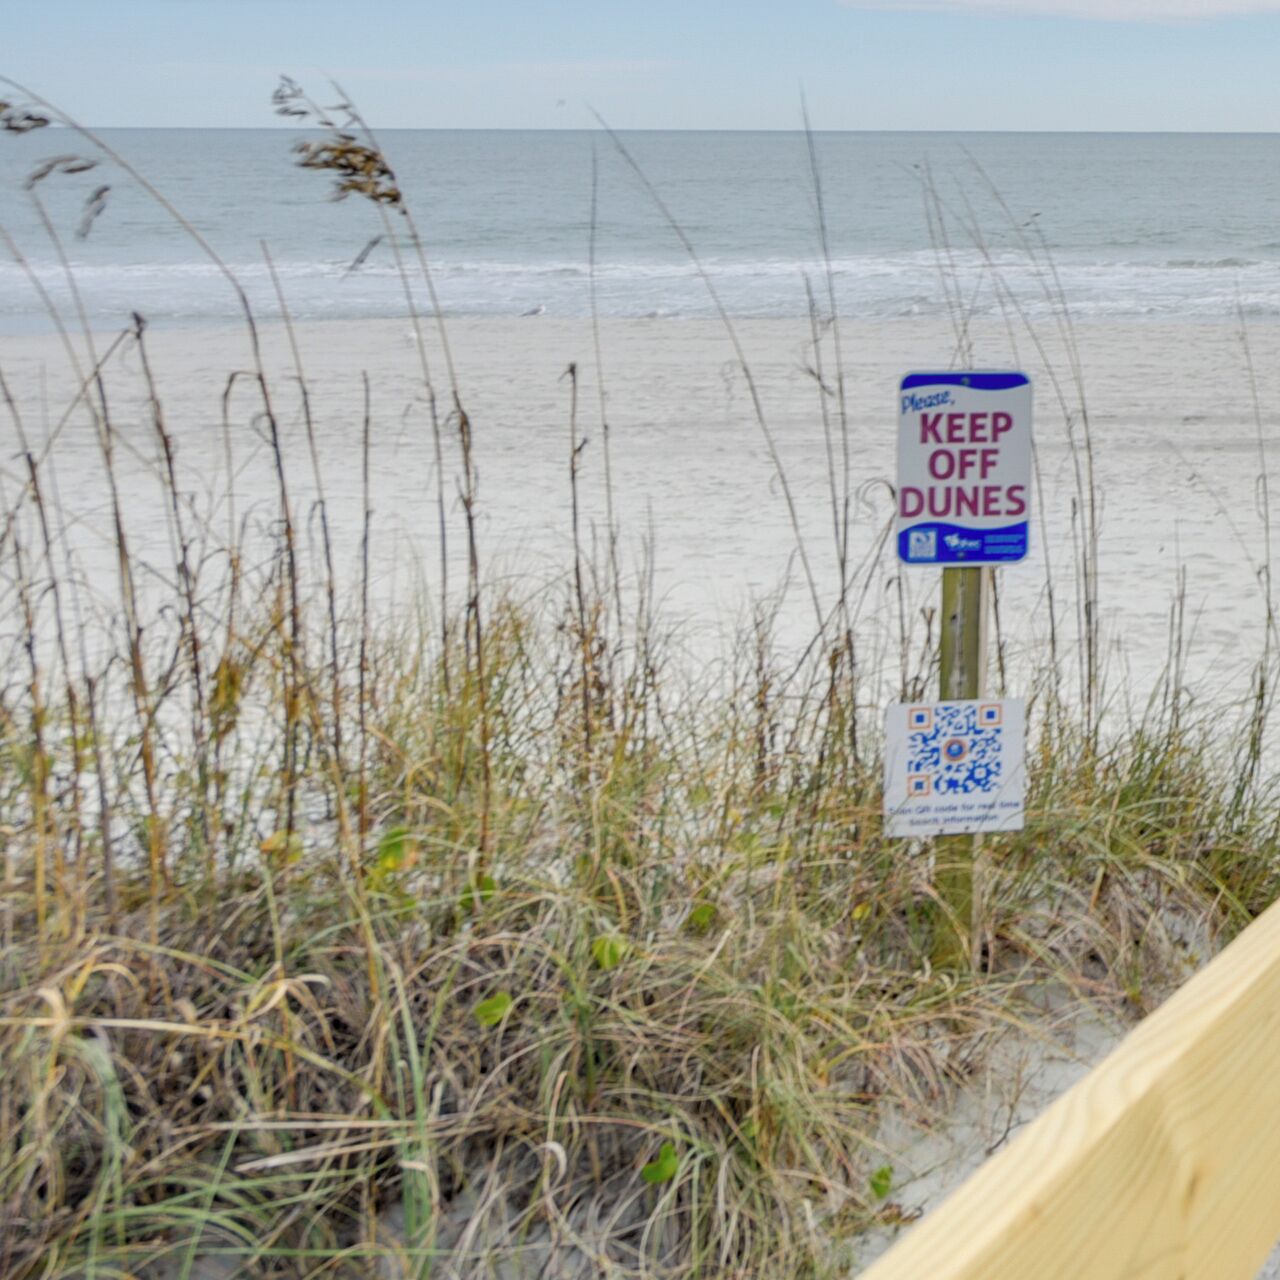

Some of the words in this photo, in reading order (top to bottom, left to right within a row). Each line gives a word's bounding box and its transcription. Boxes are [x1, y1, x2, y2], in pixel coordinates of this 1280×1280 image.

[902, 391, 955, 414] Please,
[920, 413, 1012, 443] KEEP
[929, 449, 999, 479] OFF
[900, 485, 1026, 517] DUNES
